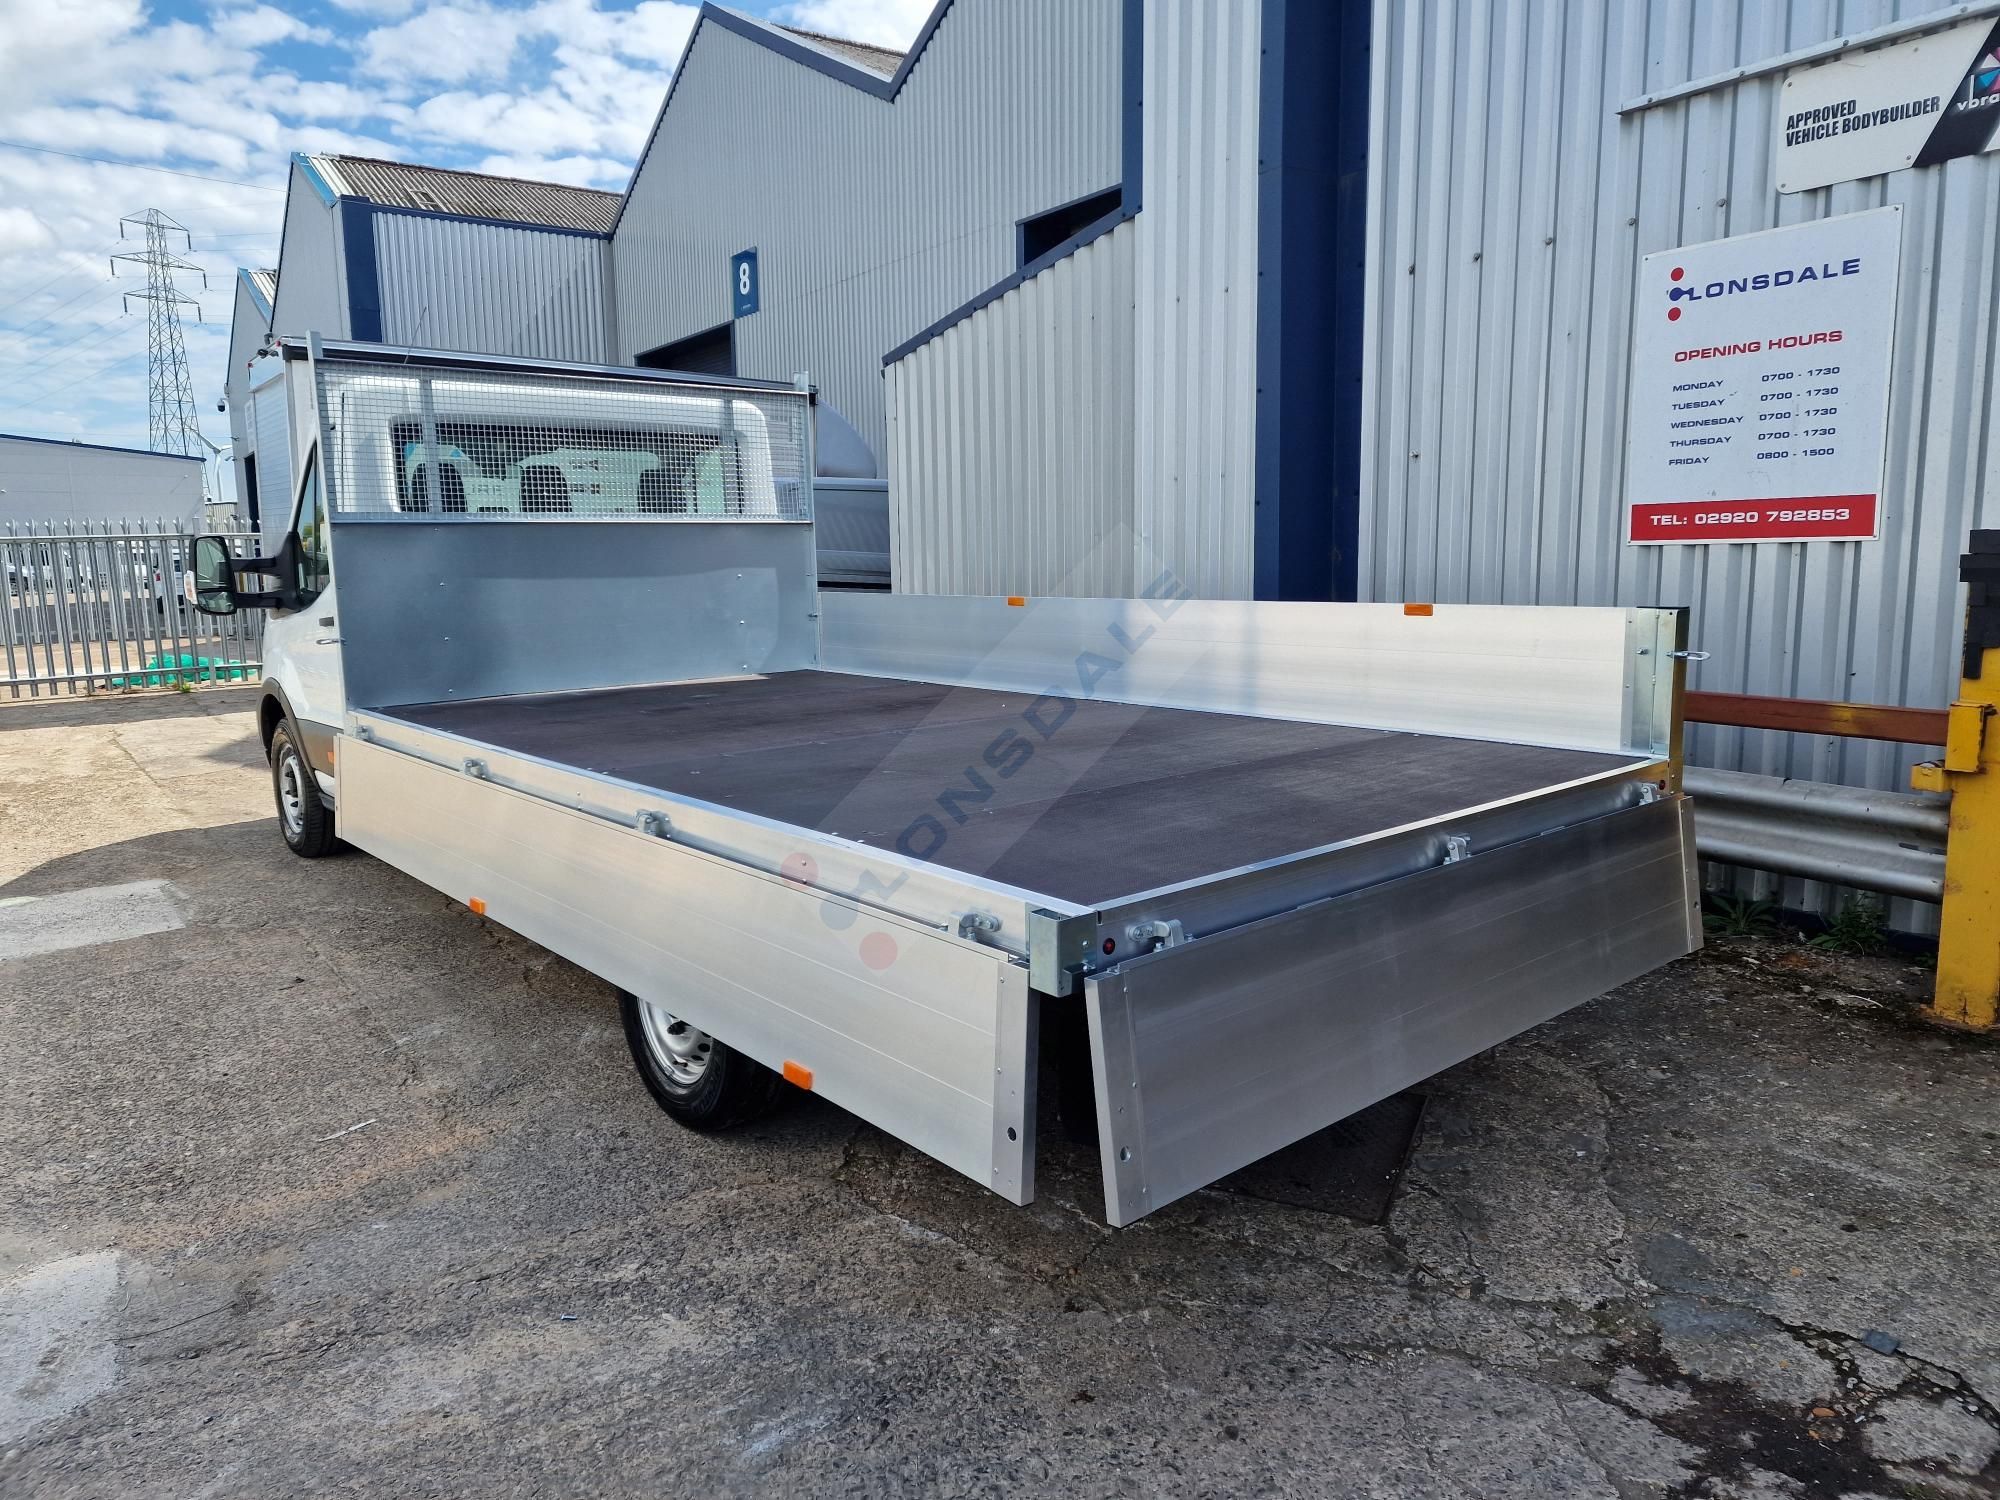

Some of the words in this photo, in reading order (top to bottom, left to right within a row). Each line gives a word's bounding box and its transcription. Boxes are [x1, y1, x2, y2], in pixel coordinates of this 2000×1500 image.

[1957, 74, 2000, 110] vbra
[1786, 99, 1857, 131] APPROVED
[1786, 121, 1839, 147] VEHICLE
[1842, 96, 1941, 134] BODYBUILDER
[739, 262, 750, 295] 8
[1688, 258, 1861, 301] LONSDALE
[1674, 341, 1761, 362] OPENING
[1768, 330, 1843, 350] HOURS
[1672, 380, 1724, 392] MONDAY
[1761, 371, 1794, 382] 0700
[1807, 366, 1840, 378] 1730
[1672, 399, 1725, 411] TUESDAY
[1760, 391, 1793, 401] 0700
[1806, 387, 1839, 397] 1730
[1670, 416, 1744, 429] WEDNESDAY
[1759, 411, 1791, 421] 0700
[1804, 407, 1837, 417] 1730
[1669, 436, 1732, 448] THURSDAY
[1757, 431, 1790, 440] 0700
[1803, 427, 1836, 437] 1730
[1668, 456, 1709, 466] FRIDAY
[1756, 450, 1789, 460] 0800
[1802, 447, 1834, 457] 1500
[1650, 514, 1688, 526] TEL:
[1694, 511, 1759, 525] 02920
[1766, 508, 1850, 522] 792853
